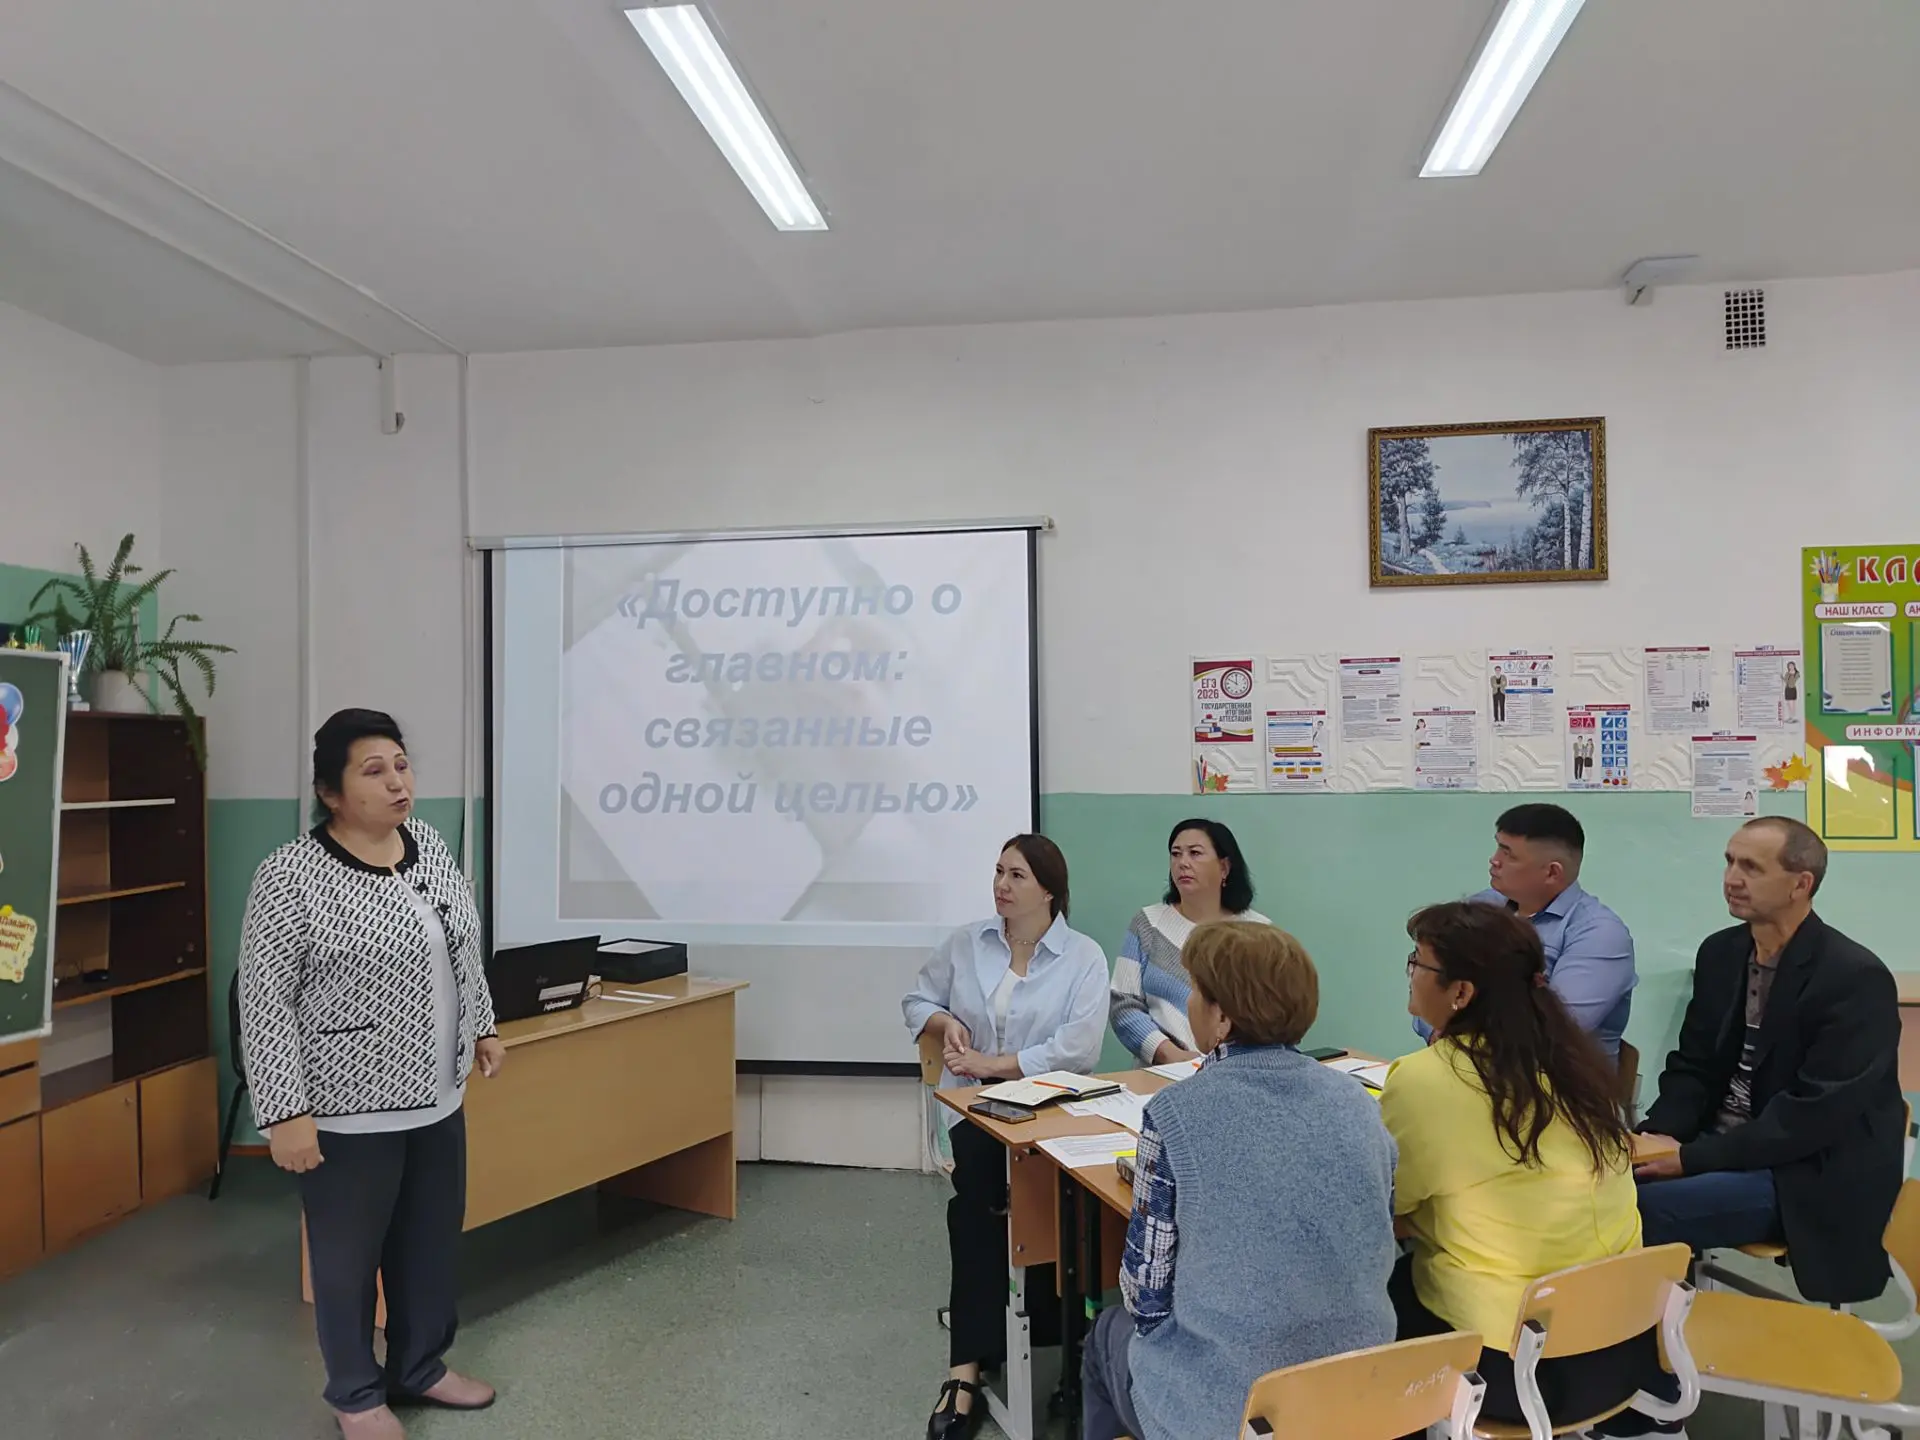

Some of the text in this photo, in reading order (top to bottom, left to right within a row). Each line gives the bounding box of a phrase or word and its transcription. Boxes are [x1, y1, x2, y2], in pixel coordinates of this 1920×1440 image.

[617, 578, 962, 629] «Доступно о
[1825, 605, 1885, 616] НАШ КЛАСС
[665, 650, 908, 683] главном:
[1201, 678, 1217, 688] ЕГЭ
[1197, 689, 1219, 699] 2026
[1200, 702, 1252, 710] ГОСУДАРСТВЕННАЯ
[644, 715, 932, 748] связанные
[1853, 727, 1920, 737] ИНФОРМ
[599, 770, 979, 820] одной целью»
